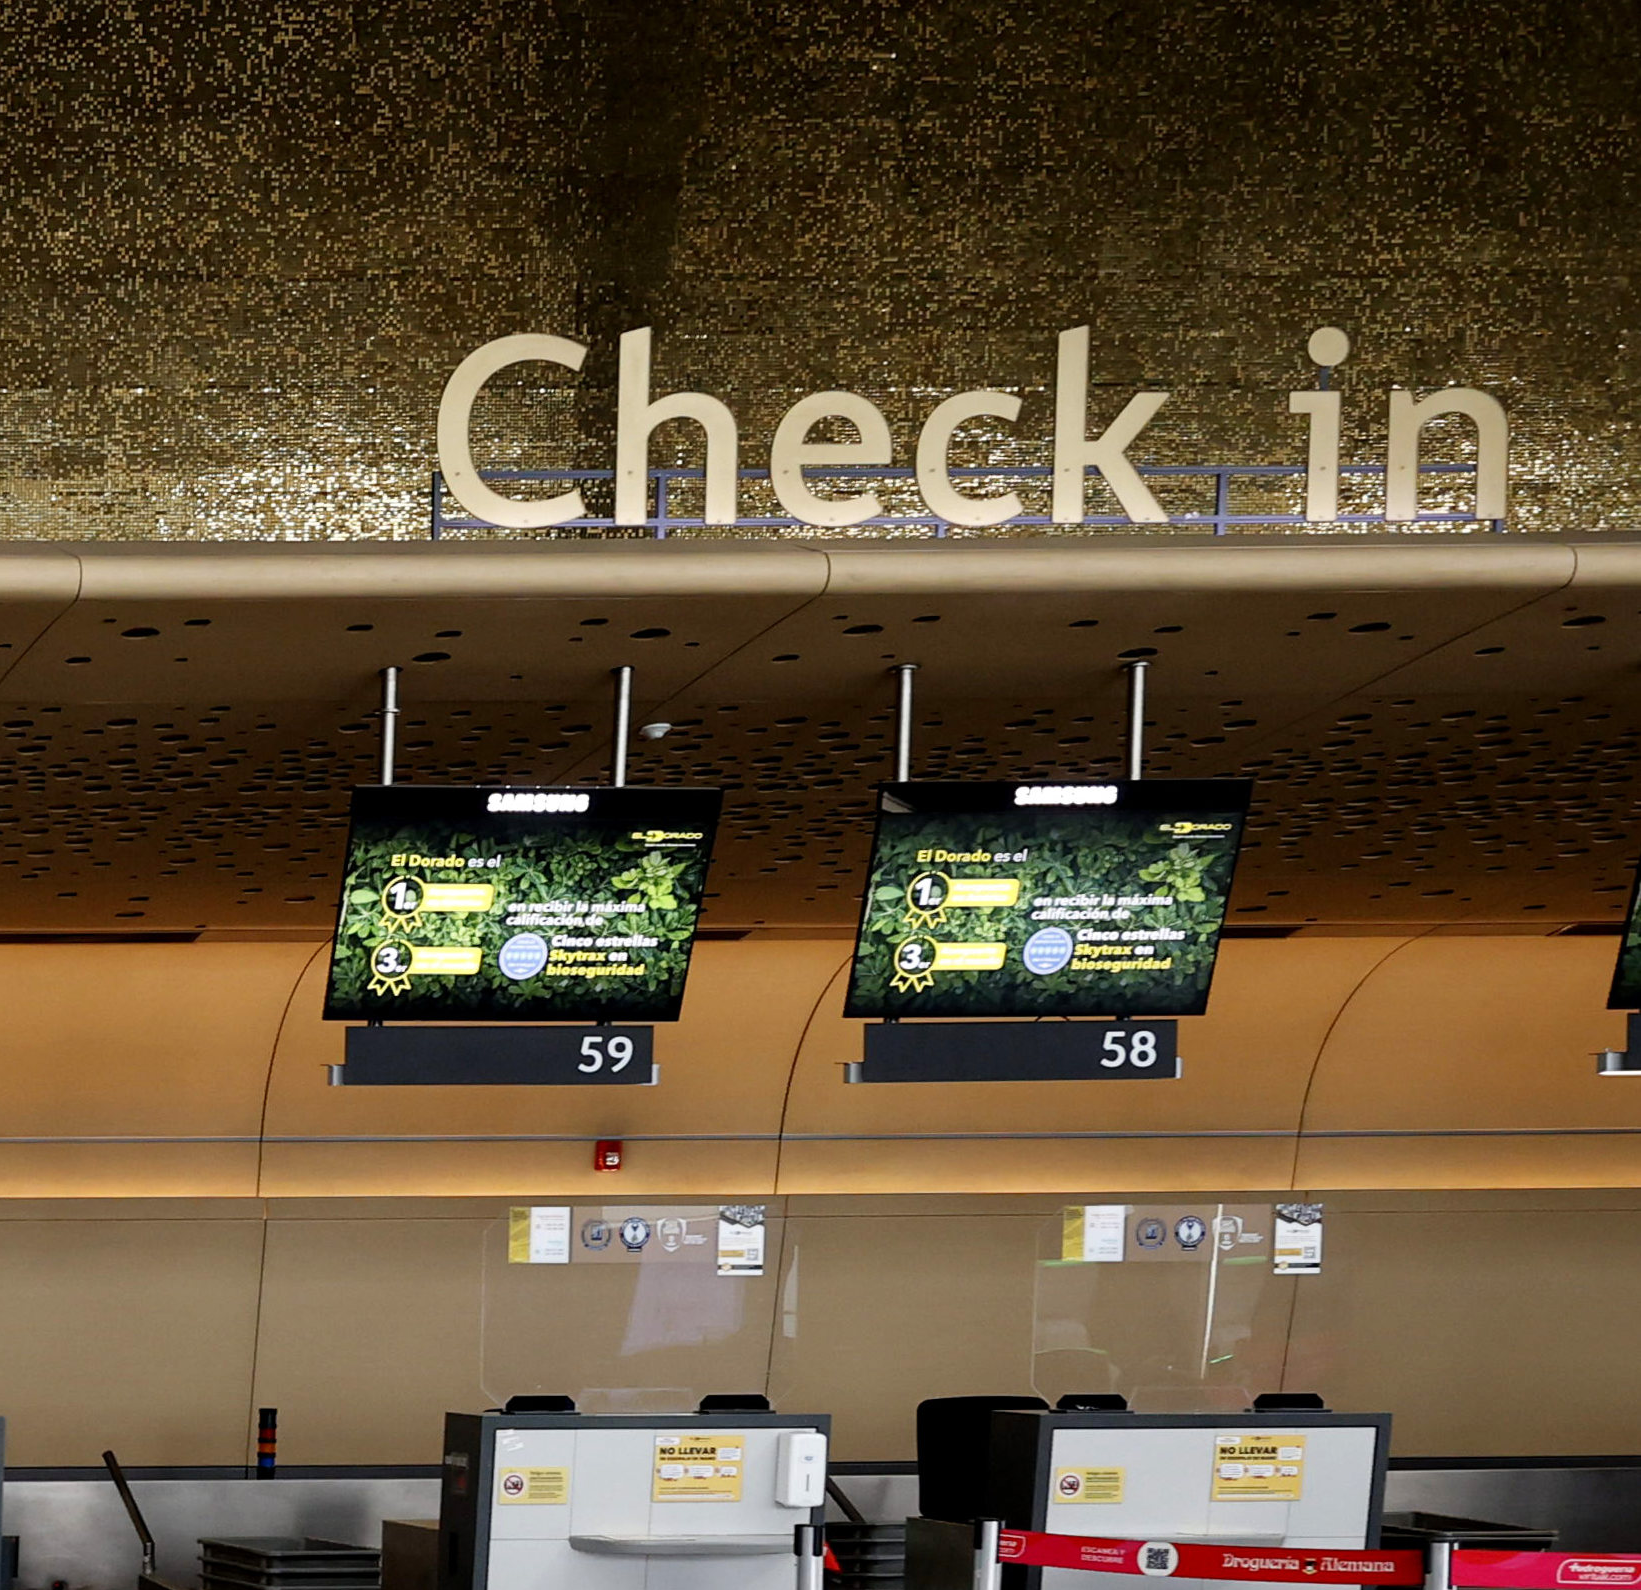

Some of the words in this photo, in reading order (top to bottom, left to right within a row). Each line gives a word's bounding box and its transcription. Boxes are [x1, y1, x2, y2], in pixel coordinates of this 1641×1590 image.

[436, 325, 1171, 530] Check
[1287, 325, 1510, 524] in
[486, 793, 590, 813] SAMSUNG
[546, 963, 645, 980] bioseguridad
[1070, 957, 1172, 974] bioseguridad
[577, 1035, 635, 1074] 59
[1100, 1030, 1158, 1068] 58
[660, 1447, 675, 1455] NO
[678, 1447, 717, 1455] LLEVAR
[1239, 1446, 1278, 1455] LLEVAR
[1221, 1552, 1300, 1572] Droguería
[1320, 1557, 1395, 1573] Alemana
